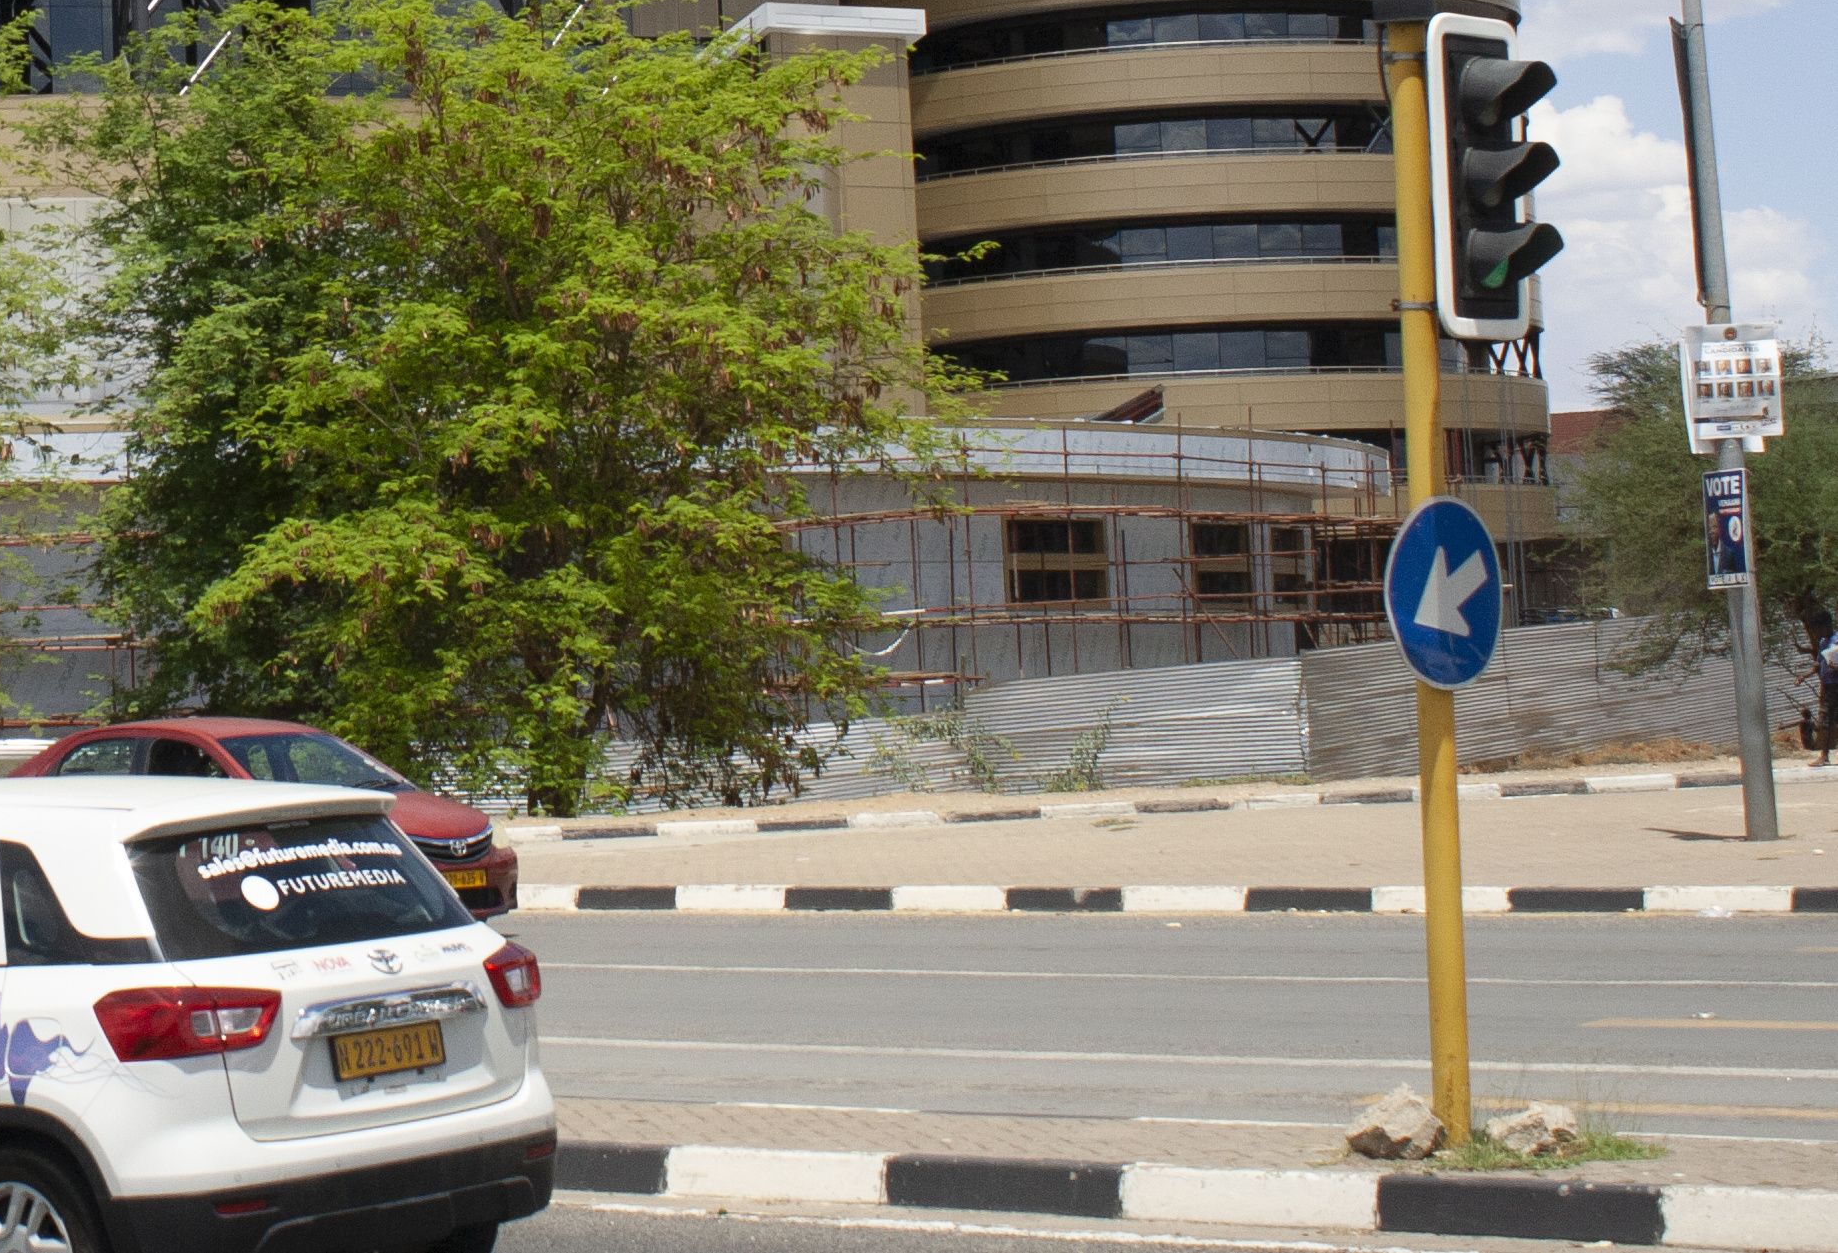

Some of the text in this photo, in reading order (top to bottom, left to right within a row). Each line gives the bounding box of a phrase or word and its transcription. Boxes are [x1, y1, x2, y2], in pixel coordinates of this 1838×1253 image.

[1705, 475, 1741, 497] VOTE
[198, 838, 402, 879] sales@futuremedia.com.na
[277, 869, 406, 895] FUTUREMEDIA
[314, 956, 350, 971] NOVA
[338, 1029, 438, 1071] N 222-691 W
